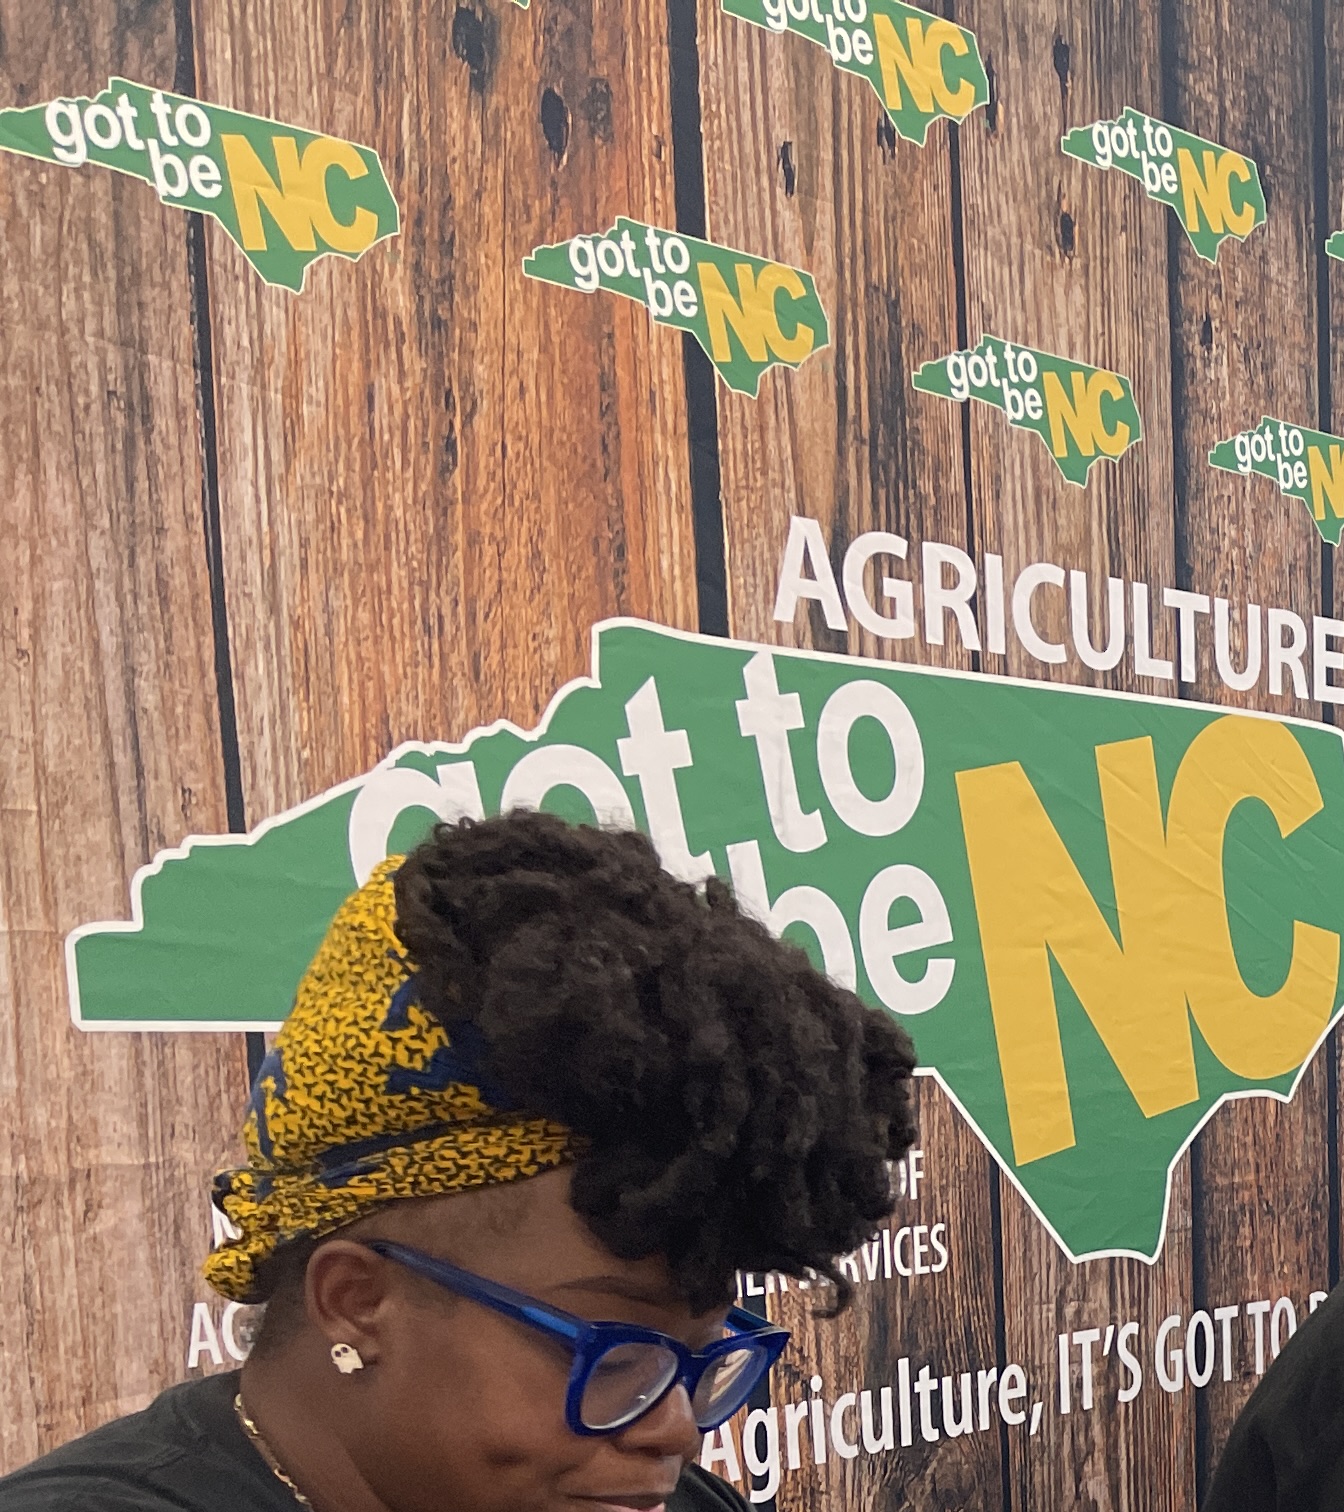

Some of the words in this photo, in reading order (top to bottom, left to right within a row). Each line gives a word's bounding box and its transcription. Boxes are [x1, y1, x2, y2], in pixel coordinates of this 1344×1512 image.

[825, 14, 874, 65] be
[873, 13, 975, 117] NC
[44, 95, 143, 163] got
[150, 91, 211, 148] to
[1092, 119, 1141, 168] got
[1141, 113, 1173, 157] to
[149, 139, 223, 198] be
[222, 134, 378, 252] NC
[1141, 153, 1178, 194] be
[1177, 149, 1256, 237] NC
[567, 232, 642, 292] got
[644, 227, 690, 275] to
[644, 267, 698, 318] be
[698, 262, 814, 363] NC
[946, 347, 999, 399] got
[1002, 342, 1038, 383] to
[1002, 378, 1042, 422] be
[1042, 369, 1130, 458] NC
[1234, 430, 1275, 473] got
[1277, 425, 1305, 457] to
[1277, 453, 1308, 489] be
[735, 649, 925, 853] to
[954, 713, 1342, 1166] NC
[701, 1357, 1043, 1503] Agriculture,
[1059, 1321, 1143, 1415] IT'S
[1155, 1306, 1239, 1393] GOT
[1246, 1297, 1298, 1375] TO
